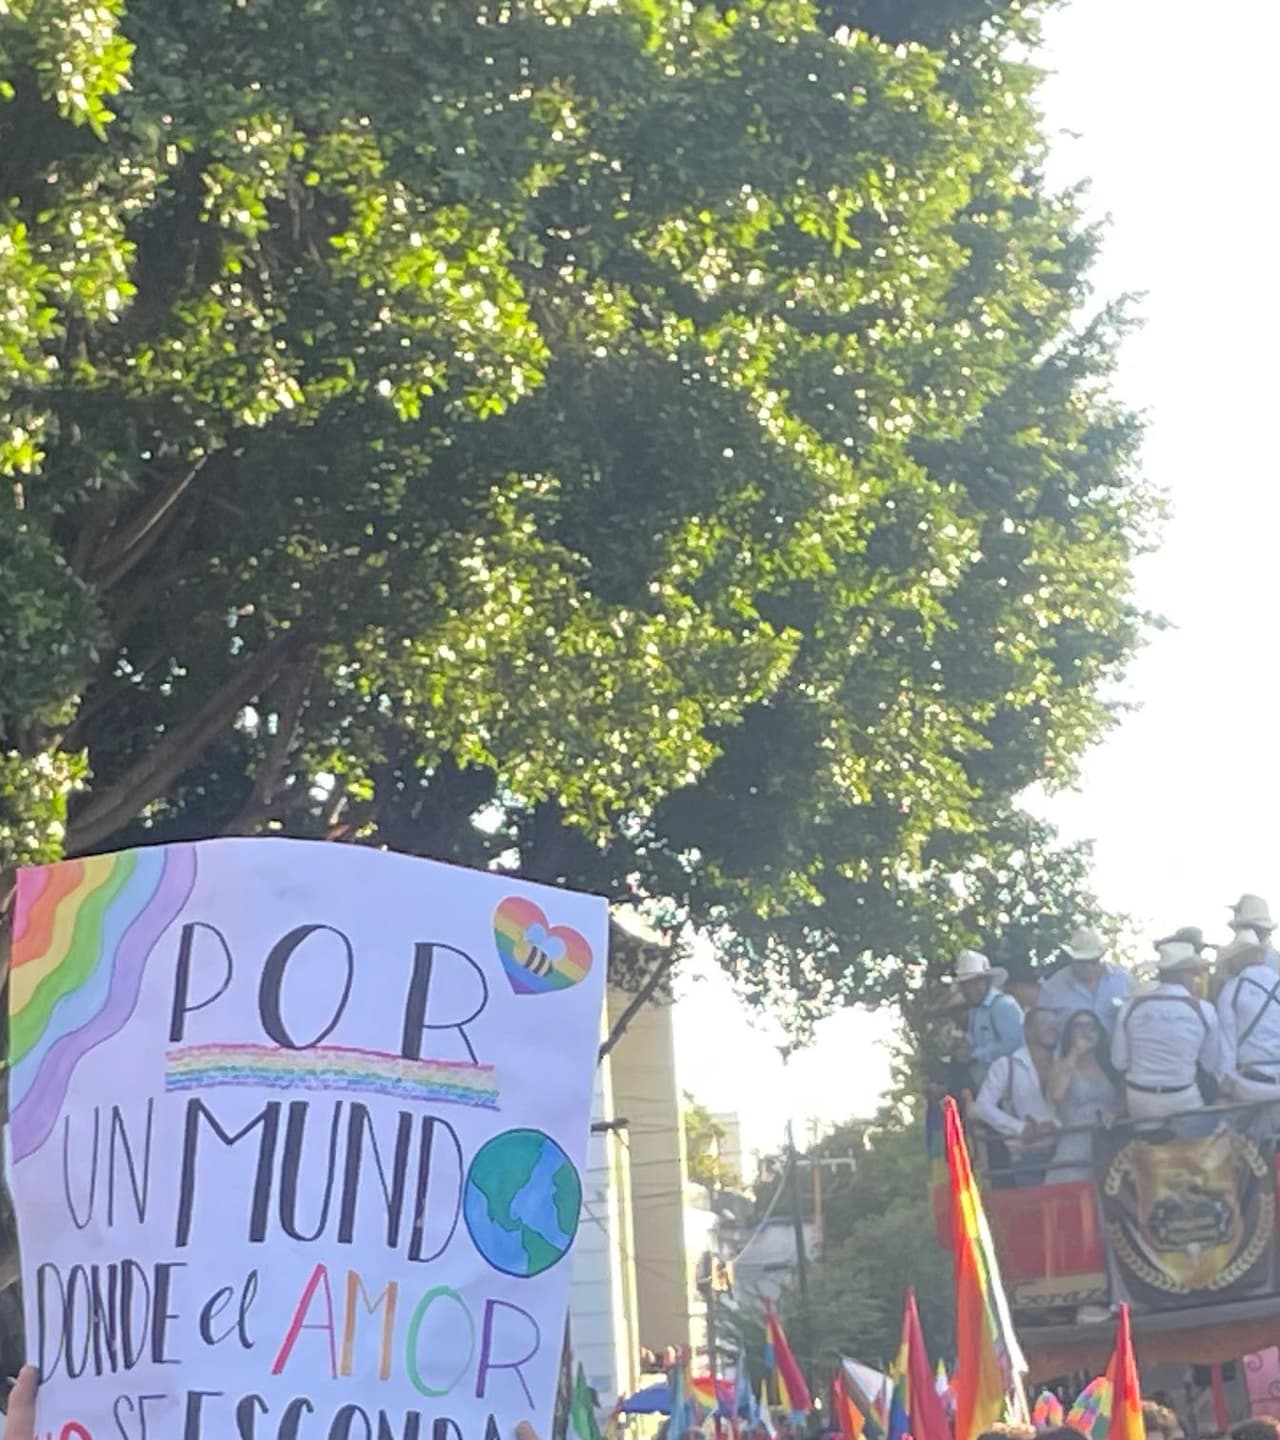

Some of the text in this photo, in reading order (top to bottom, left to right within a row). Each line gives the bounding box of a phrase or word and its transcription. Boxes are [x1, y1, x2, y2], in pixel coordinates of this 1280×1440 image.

[169, 921, 489, 1065] POR
[63, 1097, 154, 1230] UN
[35, 1259, 541, 1409] DONDE el AMOR
